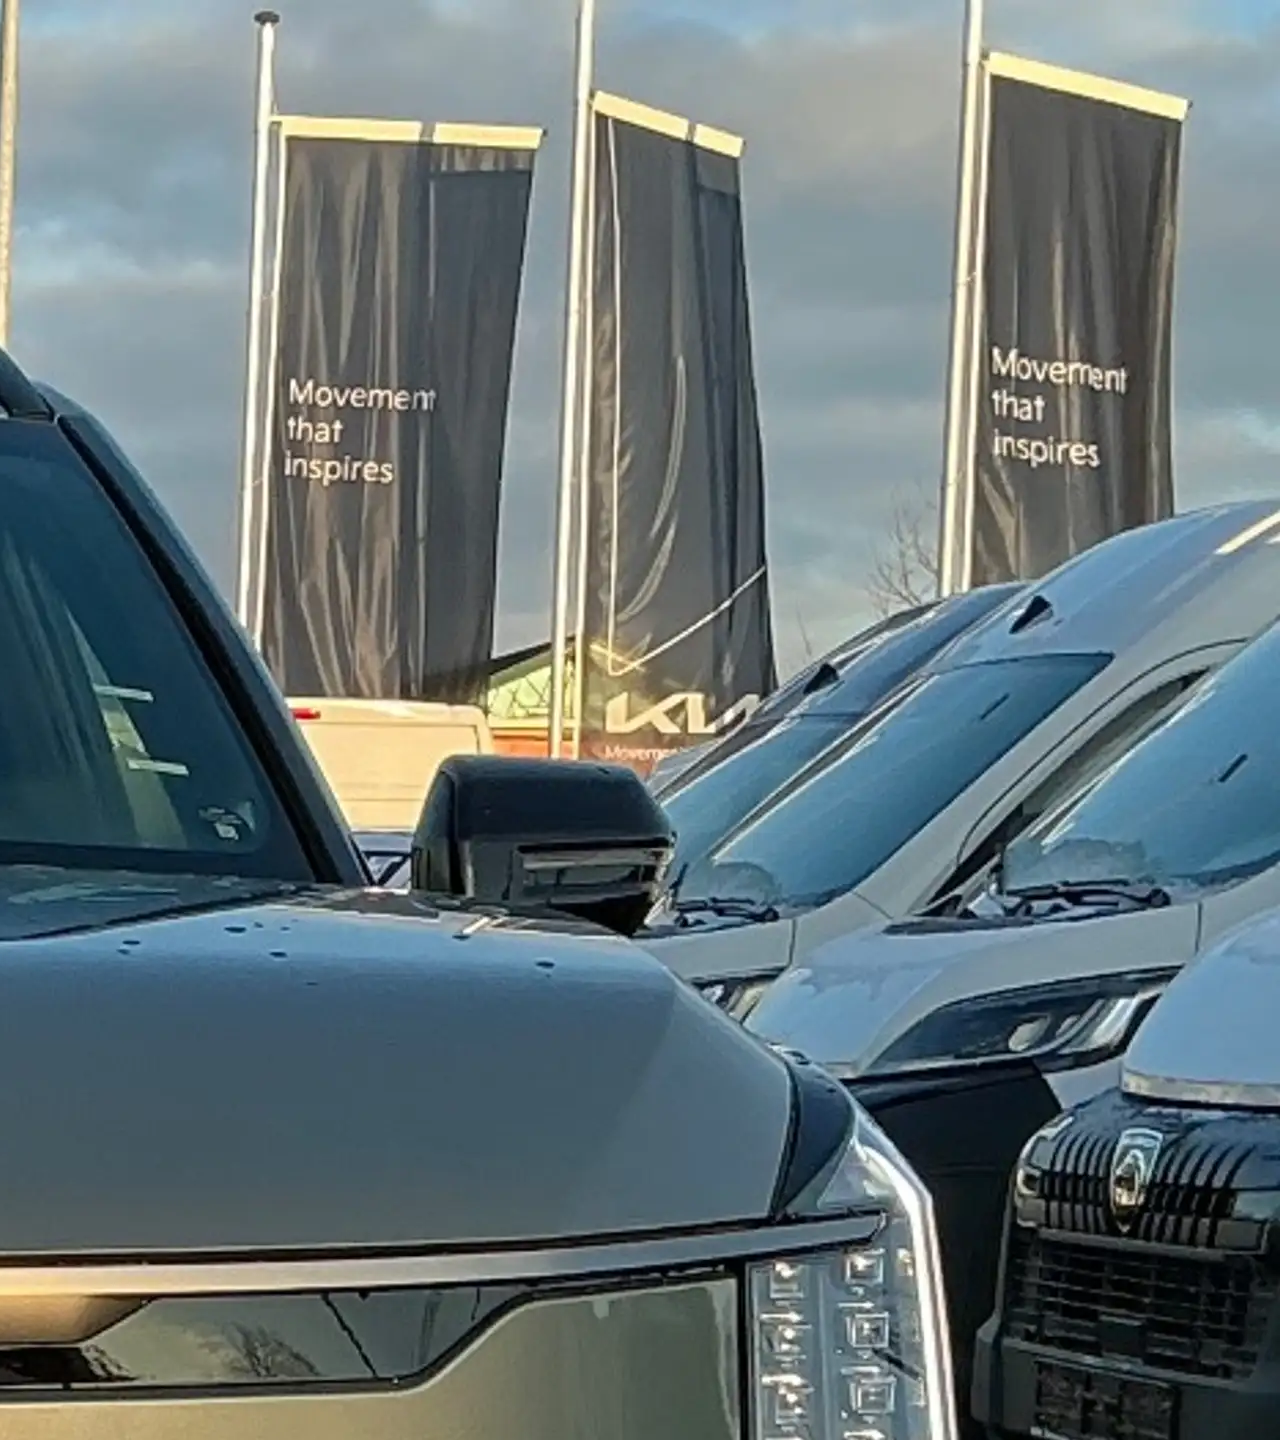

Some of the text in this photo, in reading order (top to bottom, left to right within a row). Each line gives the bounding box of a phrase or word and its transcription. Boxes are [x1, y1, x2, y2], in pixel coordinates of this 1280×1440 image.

[991, 346, 1128, 394] Movement
[289, 377, 436, 411] Movement
[991, 389, 1045, 422] that
[287, 415, 343, 443] that
[992, 428, 1100, 468] inspires
[284, 451, 394, 486] inspires
